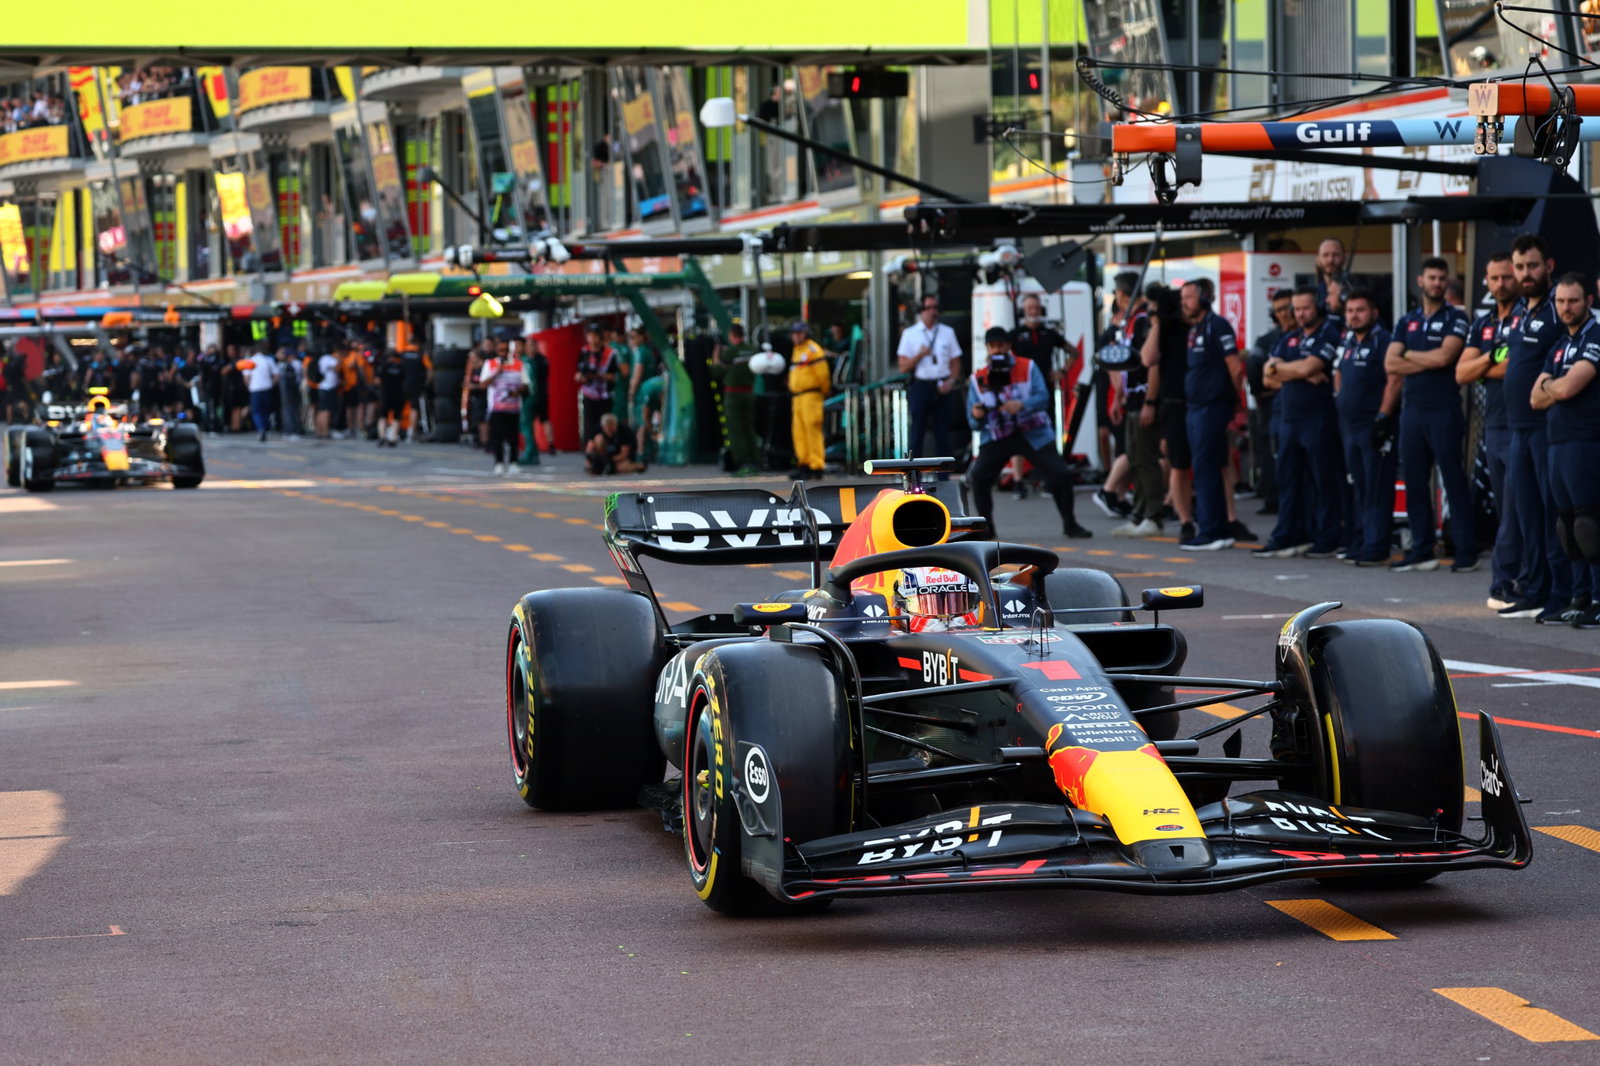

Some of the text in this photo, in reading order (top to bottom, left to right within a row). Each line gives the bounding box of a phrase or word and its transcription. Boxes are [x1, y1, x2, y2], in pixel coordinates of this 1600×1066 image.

[1296, 122, 1372, 143] Gulf
[919, 584, 967, 594] ORACLE
[926, 574, 958, 584] Red Bull
[923, 648, 959, 686] BYBIT
[1053, 703, 1118, 712] zoom
[710, 694, 724, 800] ZERO
[1077, 736, 1125, 744] Mobil
[749, 760, 767, 786] Esso
[1480, 758, 1501, 797] Claro
